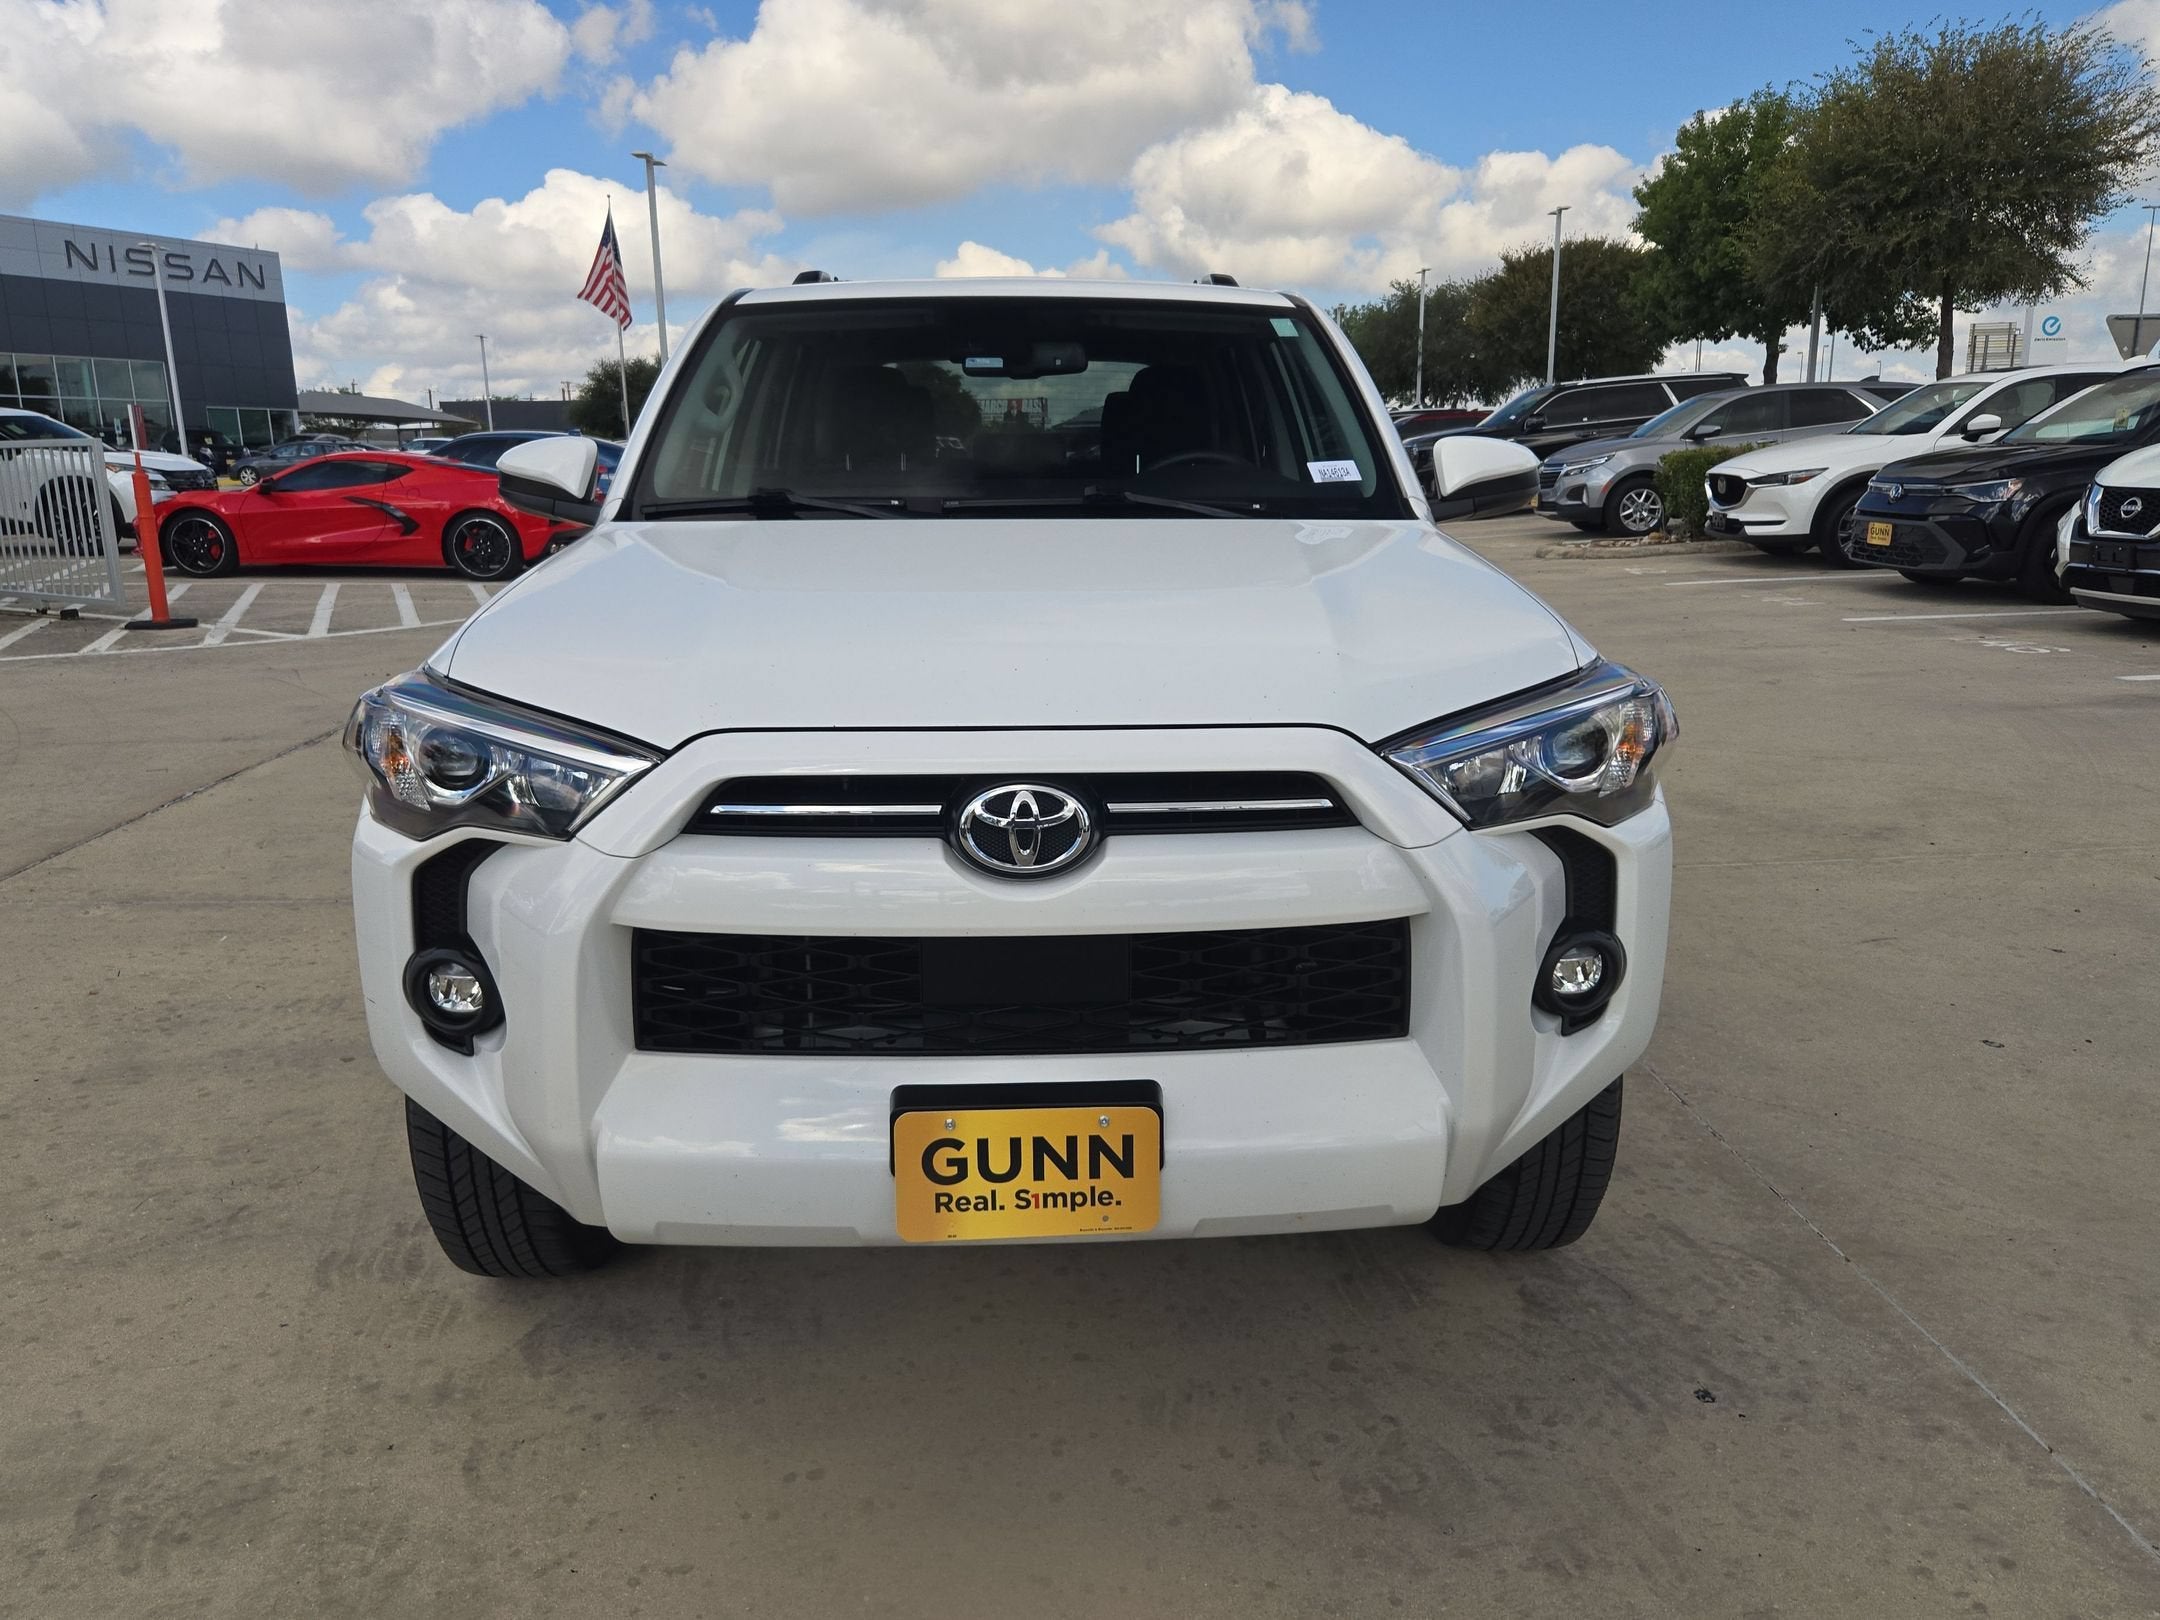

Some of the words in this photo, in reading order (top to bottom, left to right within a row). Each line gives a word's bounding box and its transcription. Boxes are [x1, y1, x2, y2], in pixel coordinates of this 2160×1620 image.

[64, 239, 266, 290] NISSAN
[1871, 527, 1890, 537] GUNN
[921, 1134, 1134, 1186] GUNN
[934, 1189, 1005, 1214] Real.
